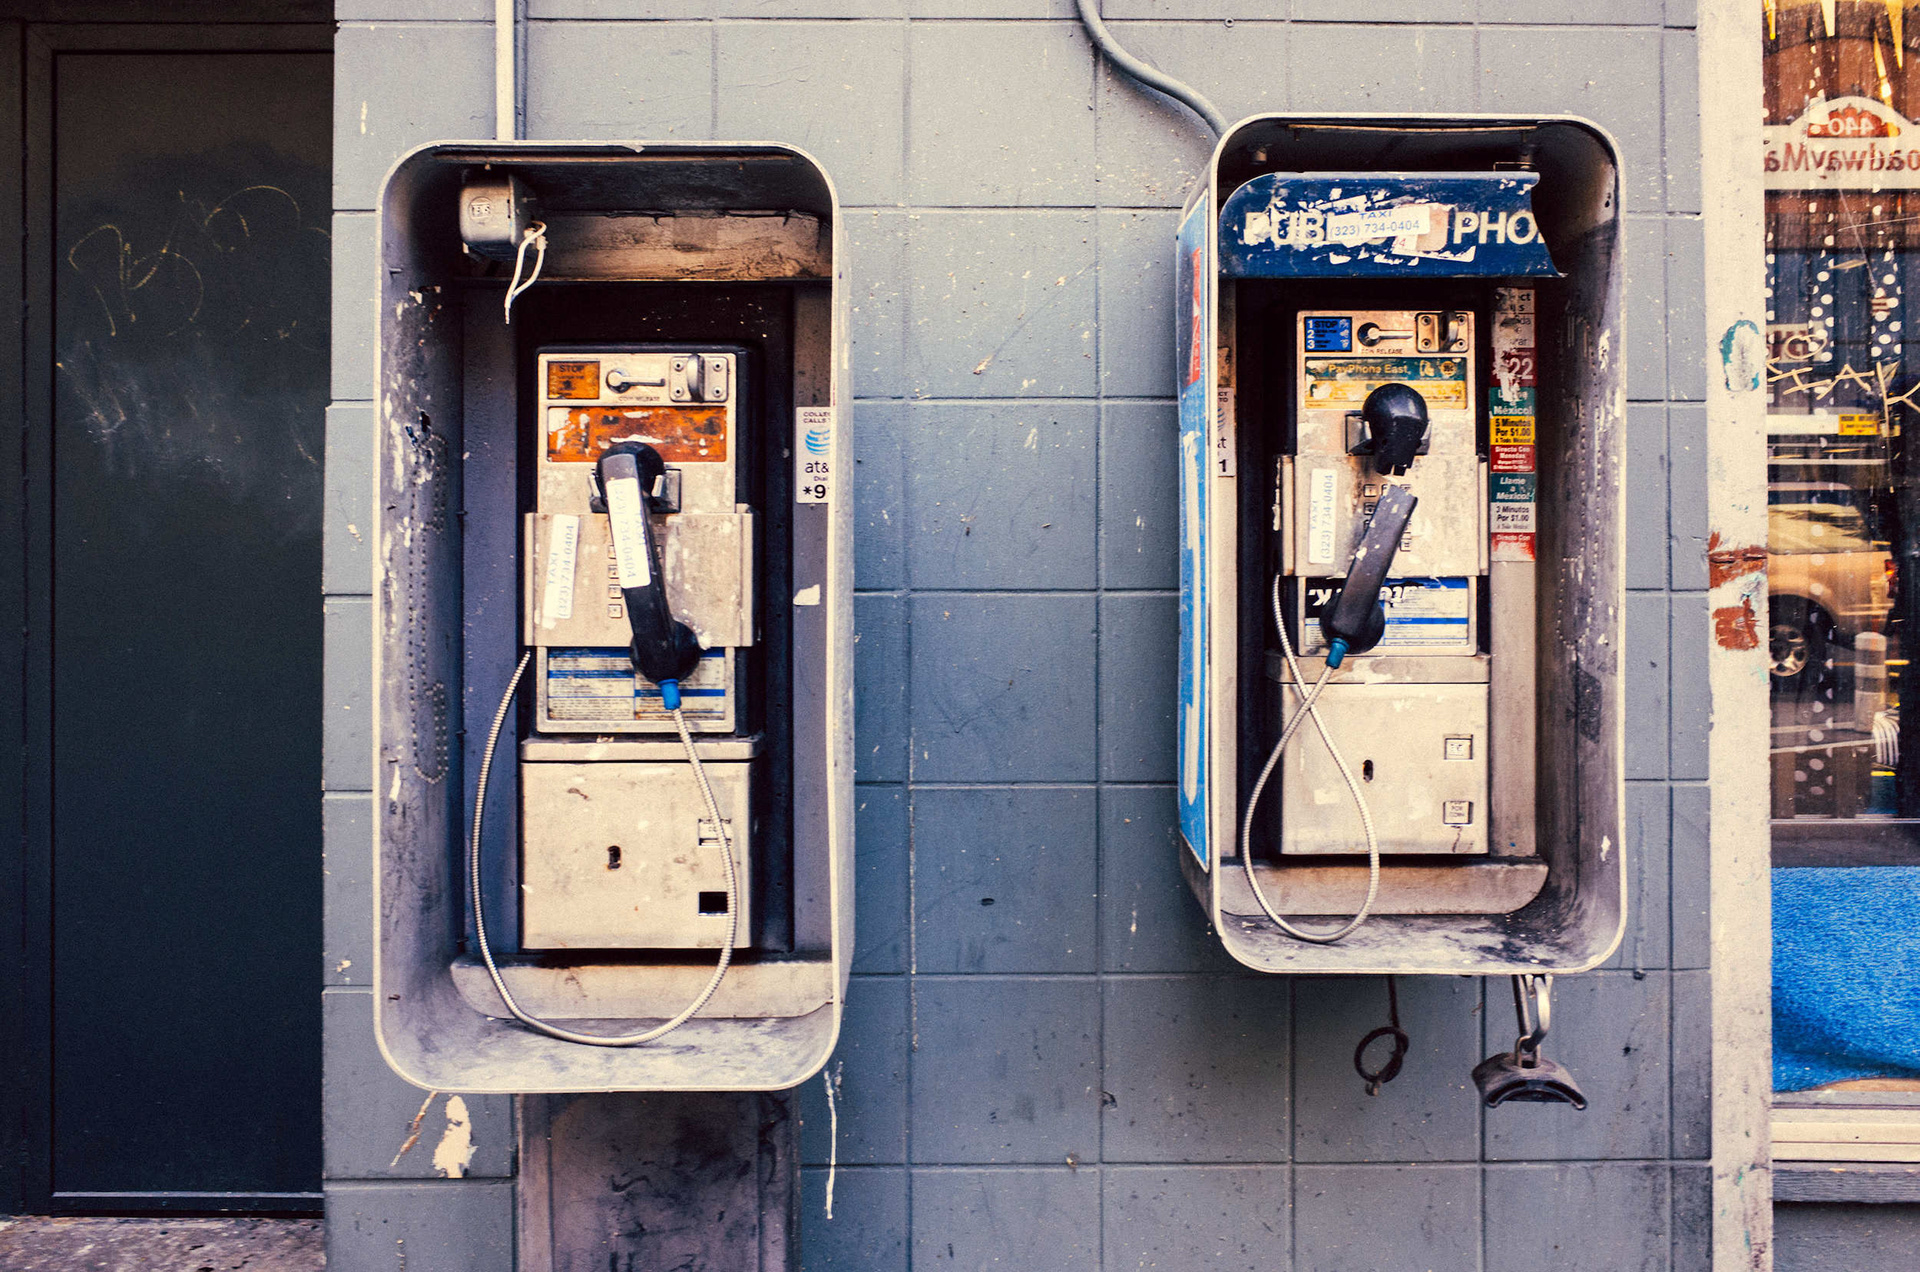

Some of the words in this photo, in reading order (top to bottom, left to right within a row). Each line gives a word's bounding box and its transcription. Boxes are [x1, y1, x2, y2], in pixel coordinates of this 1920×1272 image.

[1359, 210, 1392, 220] TAXI
[1330, 224, 1360, 240] (323)
[1364, 220, 1420, 235] 734-0404
[1453, 210, 1545, 245] PHO
[1307, 320, 1313, 328] 1
[1314, 321, 1338, 329] STOP
[1307, 329, 1315, 339] 2
[1307, 340, 1315, 349] 3
[559, 364, 585, 373] STOP
[1328, 363, 1381, 377] PayPhone
[1495, 418, 1500, 427] 5
[1502, 418, 1531, 427] Minutos
[1495, 427, 1508, 437] Por
[1322, 474, 1334, 526] 734-0404
[1321, 529, 1332, 559] (323)
[547, 552, 558, 584] TAXI
